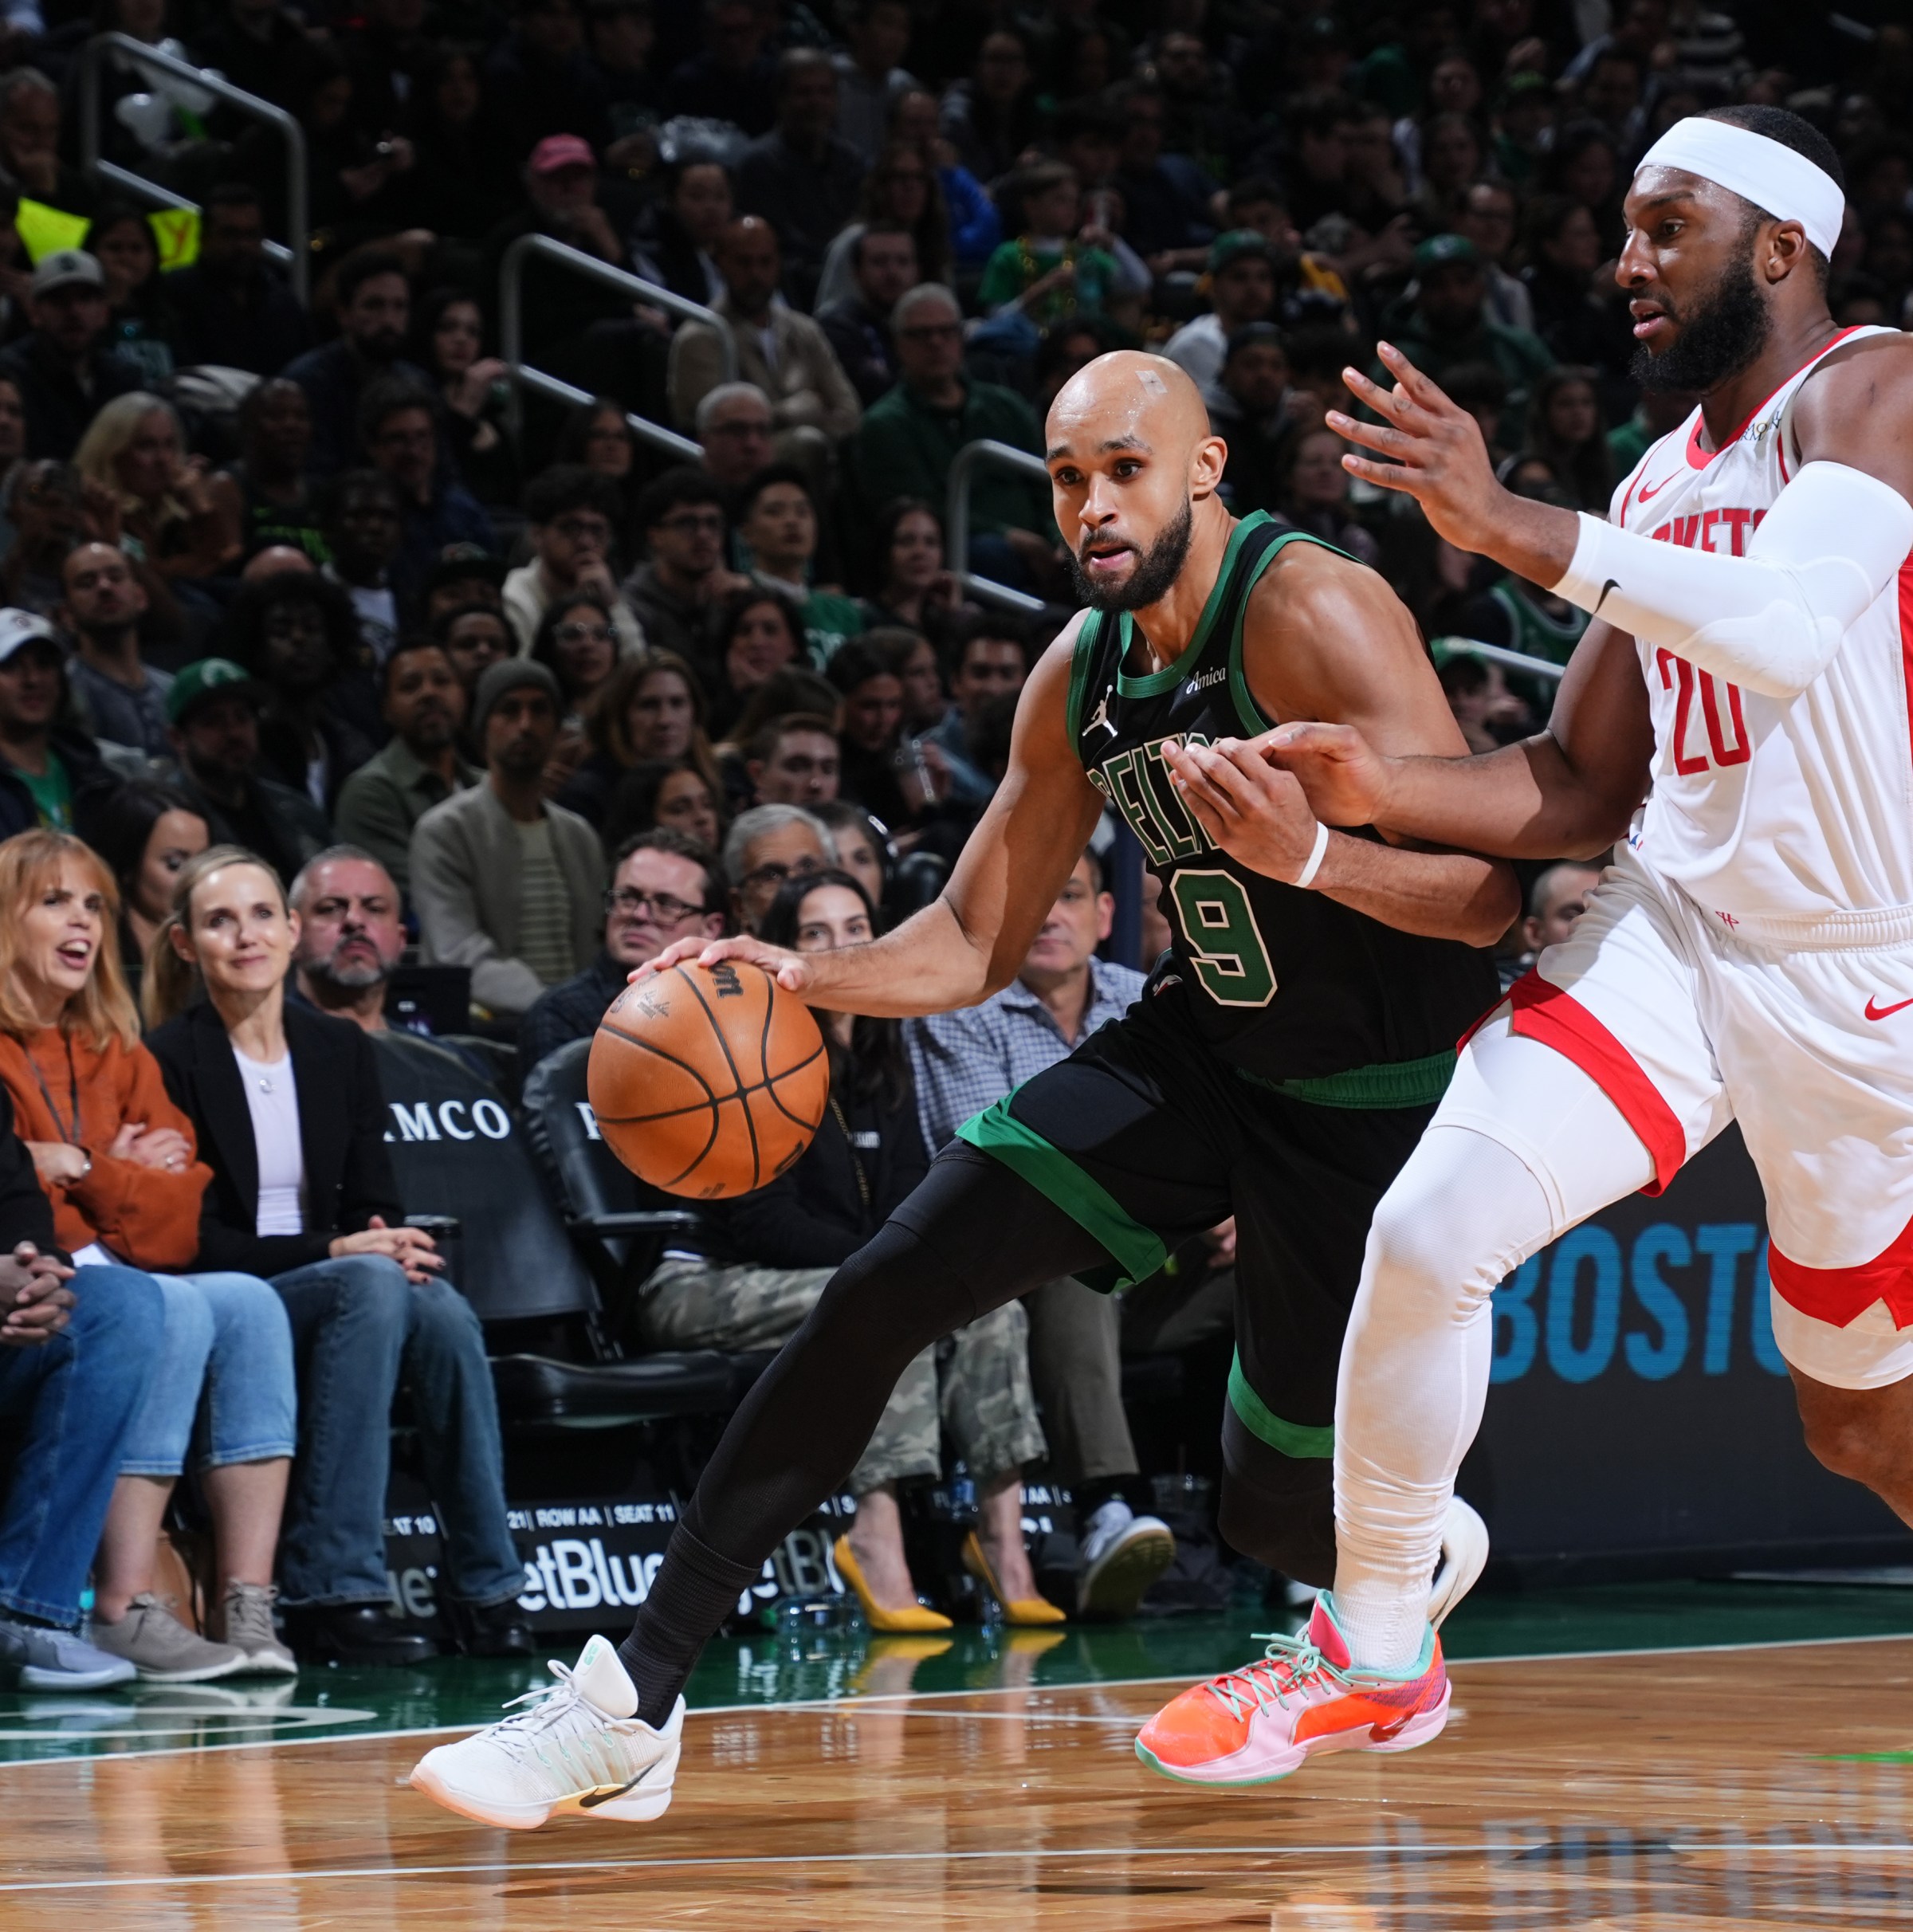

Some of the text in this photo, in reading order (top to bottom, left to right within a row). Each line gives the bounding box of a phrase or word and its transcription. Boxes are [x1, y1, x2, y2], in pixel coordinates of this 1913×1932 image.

[1185, 666, 1226, 695] Amica
[1656, 647, 1751, 776] 20
[1169, 869, 1279, 1008] 9
[383, 1098, 511, 1142] MCO
[414, 1515, 437, 1535] 10
[535, 1507, 576, 1528] ROW
[578, 1506, 603, 1526] AA
[613, 1503, 654, 1524] SEAT
[655, 1502, 675, 1522] 11
